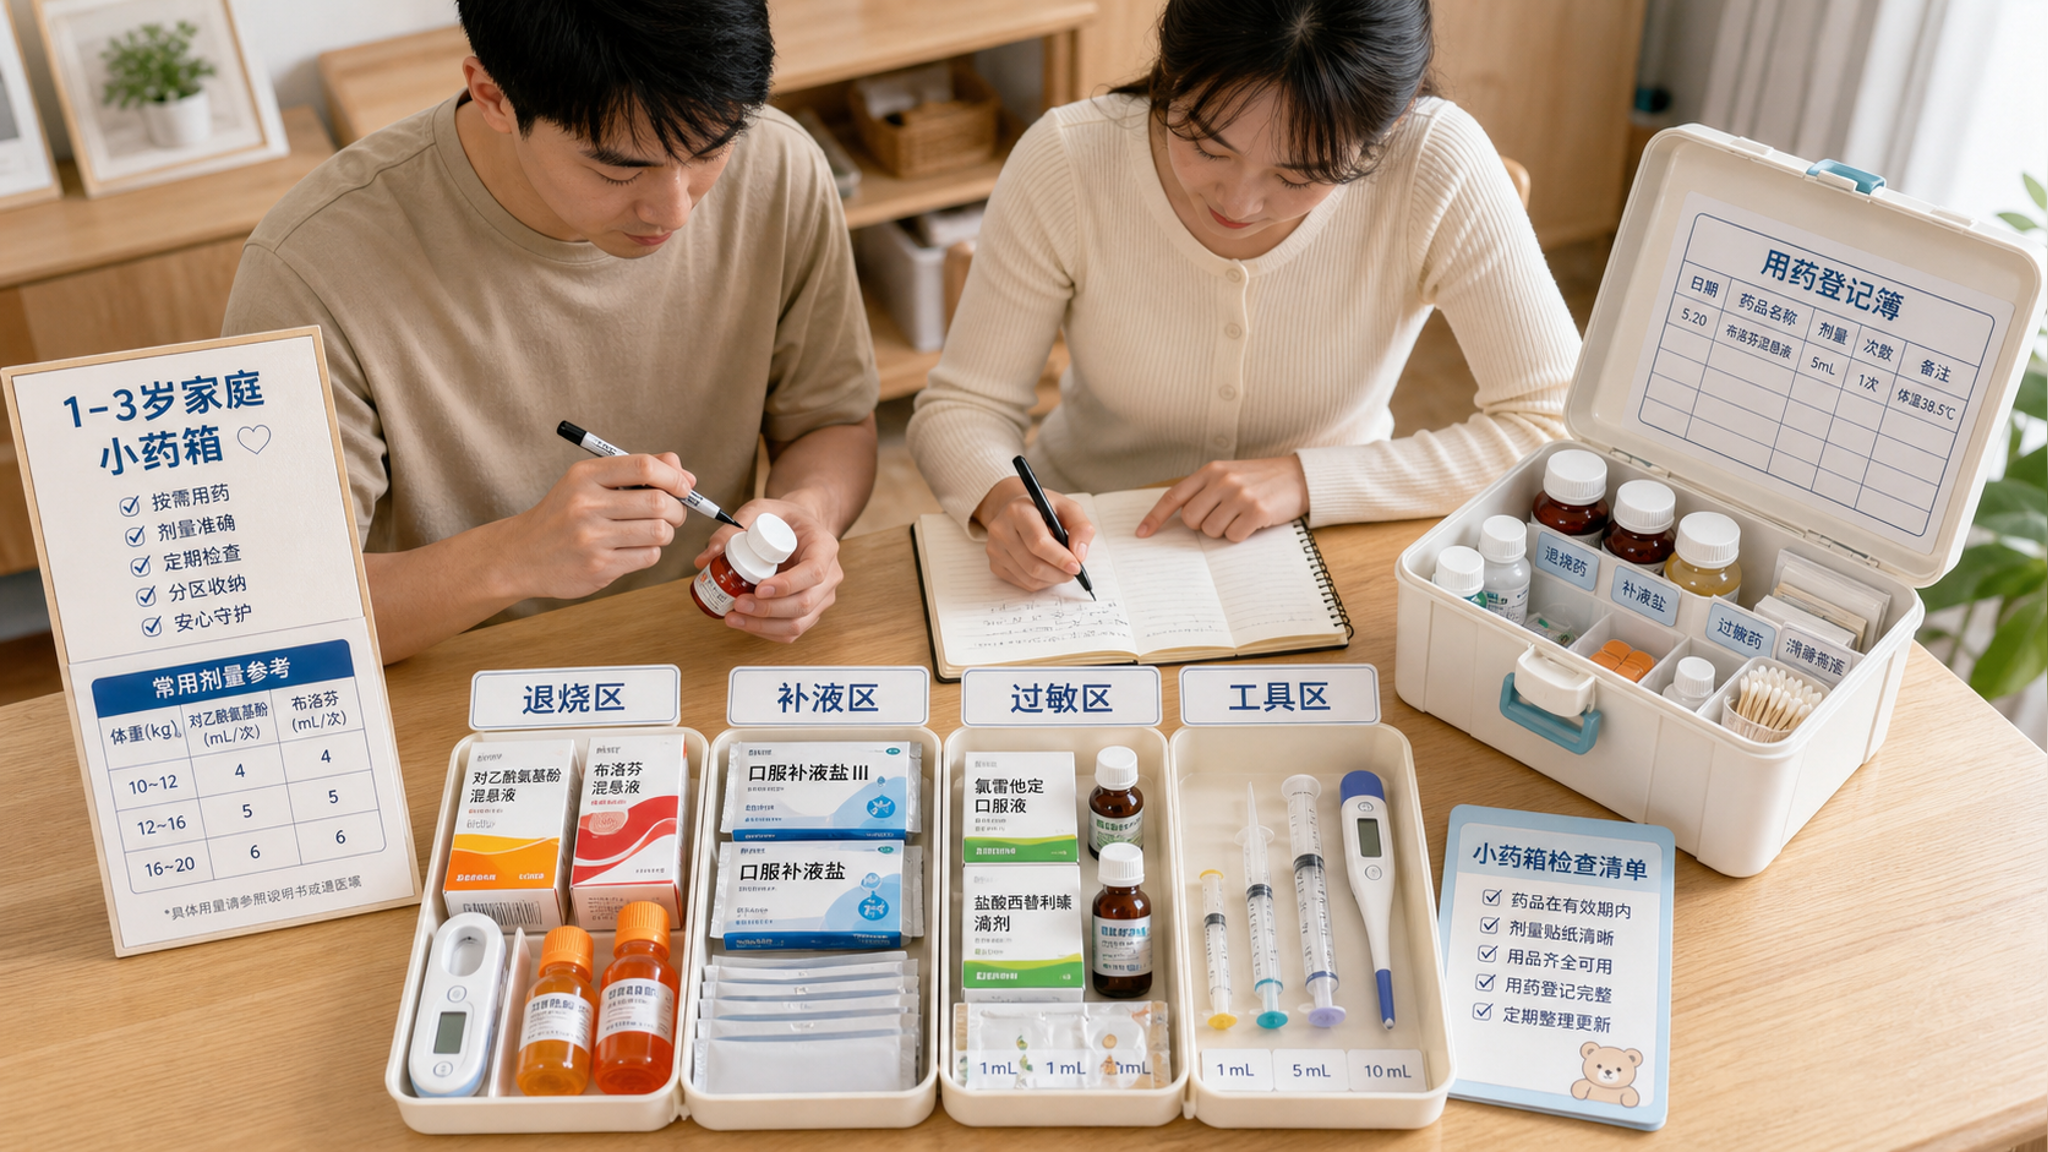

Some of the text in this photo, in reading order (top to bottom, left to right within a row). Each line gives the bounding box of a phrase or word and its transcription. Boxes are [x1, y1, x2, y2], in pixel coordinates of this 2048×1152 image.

[1690, 275, 1719, 298] 日期
[1760, 248, 1905, 322] 用药登记簿
[1681, 307, 1708, 327] 5.20
[1738, 292, 1798, 326] 药品名称
[1817, 321, 1849, 345] 剂量
[1863, 338, 1894, 362] 次数
[1810, 356, 1835, 376] 5mL
[1920, 359, 1951, 383] 备注
[1858, 374, 1879, 393] 1次
[63, 369, 266, 429] 1-3岁家庭
[99, 424, 224, 477] 小药箱
[151, 483, 231, 513] 按需用药
[157, 513, 236, 543] 剂量准确
[163, 543, 242, 573] 定期检查
[168, 573, 247, 603] 分区收纳
[174, 603, 252, 633] 安心守护
[152, 656, 291, 700] 常用剂量参考
[291, 690, 340, 712] 布洛芬
[522, 682, 626, 715] 退烧区
[777, 682, 879, 713] 补液区
[1010, 683, 1113, 714] 过敏区
[1228, 682, 1331, 712] 工具区
[291, 709, 348, 734] (mL/次)
[203, 724, 262, 748] (mL/次)
[320, 749, 332, 764] 4
[234, 764, 246, 778] 4
[594, 761, 643, 777] 布洛芬
[128, 774, 179, 796] 10~12
[328, 789, 339, 804] 5
[469, 787, 517, 804] 混悬液
[591, 779, 641, 796] 混悬液
[974, 778, 1044, 794] 氯雷他定
[242, 803, 253, 818] 5
[975, 797, 1027, 814] 口服液
[136, 815, 187, 837] 12~16
[335, 830, 347, 844] 6
[249, 845, 261, 860] 6
[1473, 841, 1649, 882] 小药箱检查清单
[144, 856, 196, 878] 16~20
[739, 862, 846, 881] 口服补液盐
[1511, 893, 1632, 921] 药品在有效期内
[1509, 920, 1615, 948] 剂量贴纸清晰
[1507, 948, 1613, 977] 用品齐全可用
[1505, 977, 1613, 1006] 用药登记完整
[1503, 1006, 1612, 1035] 定期整理更新
[991, 1061, 1018, 1075] mL
[1060, 1061, 1087, 1075] mL
[1217, 1063, 1255, 1077] 1 mL
[1292, 1063, 1332, 1078] 5 mL
[1364, 1063, 1412, 1078] 10 mL
